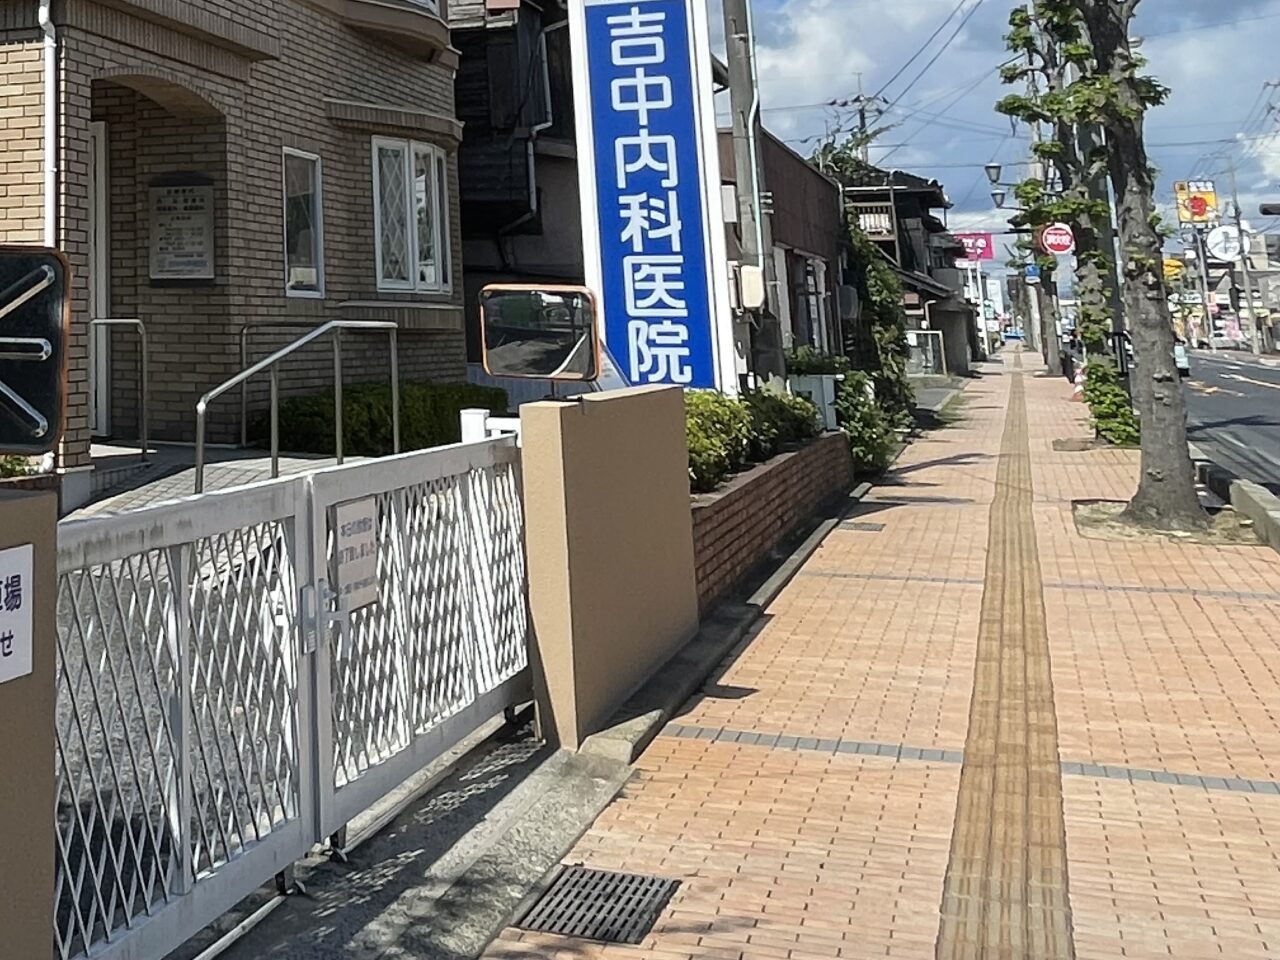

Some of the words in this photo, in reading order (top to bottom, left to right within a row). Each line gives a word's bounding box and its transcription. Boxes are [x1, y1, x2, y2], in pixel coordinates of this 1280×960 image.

[606, 6, 692, 384] 吉中内科医院
